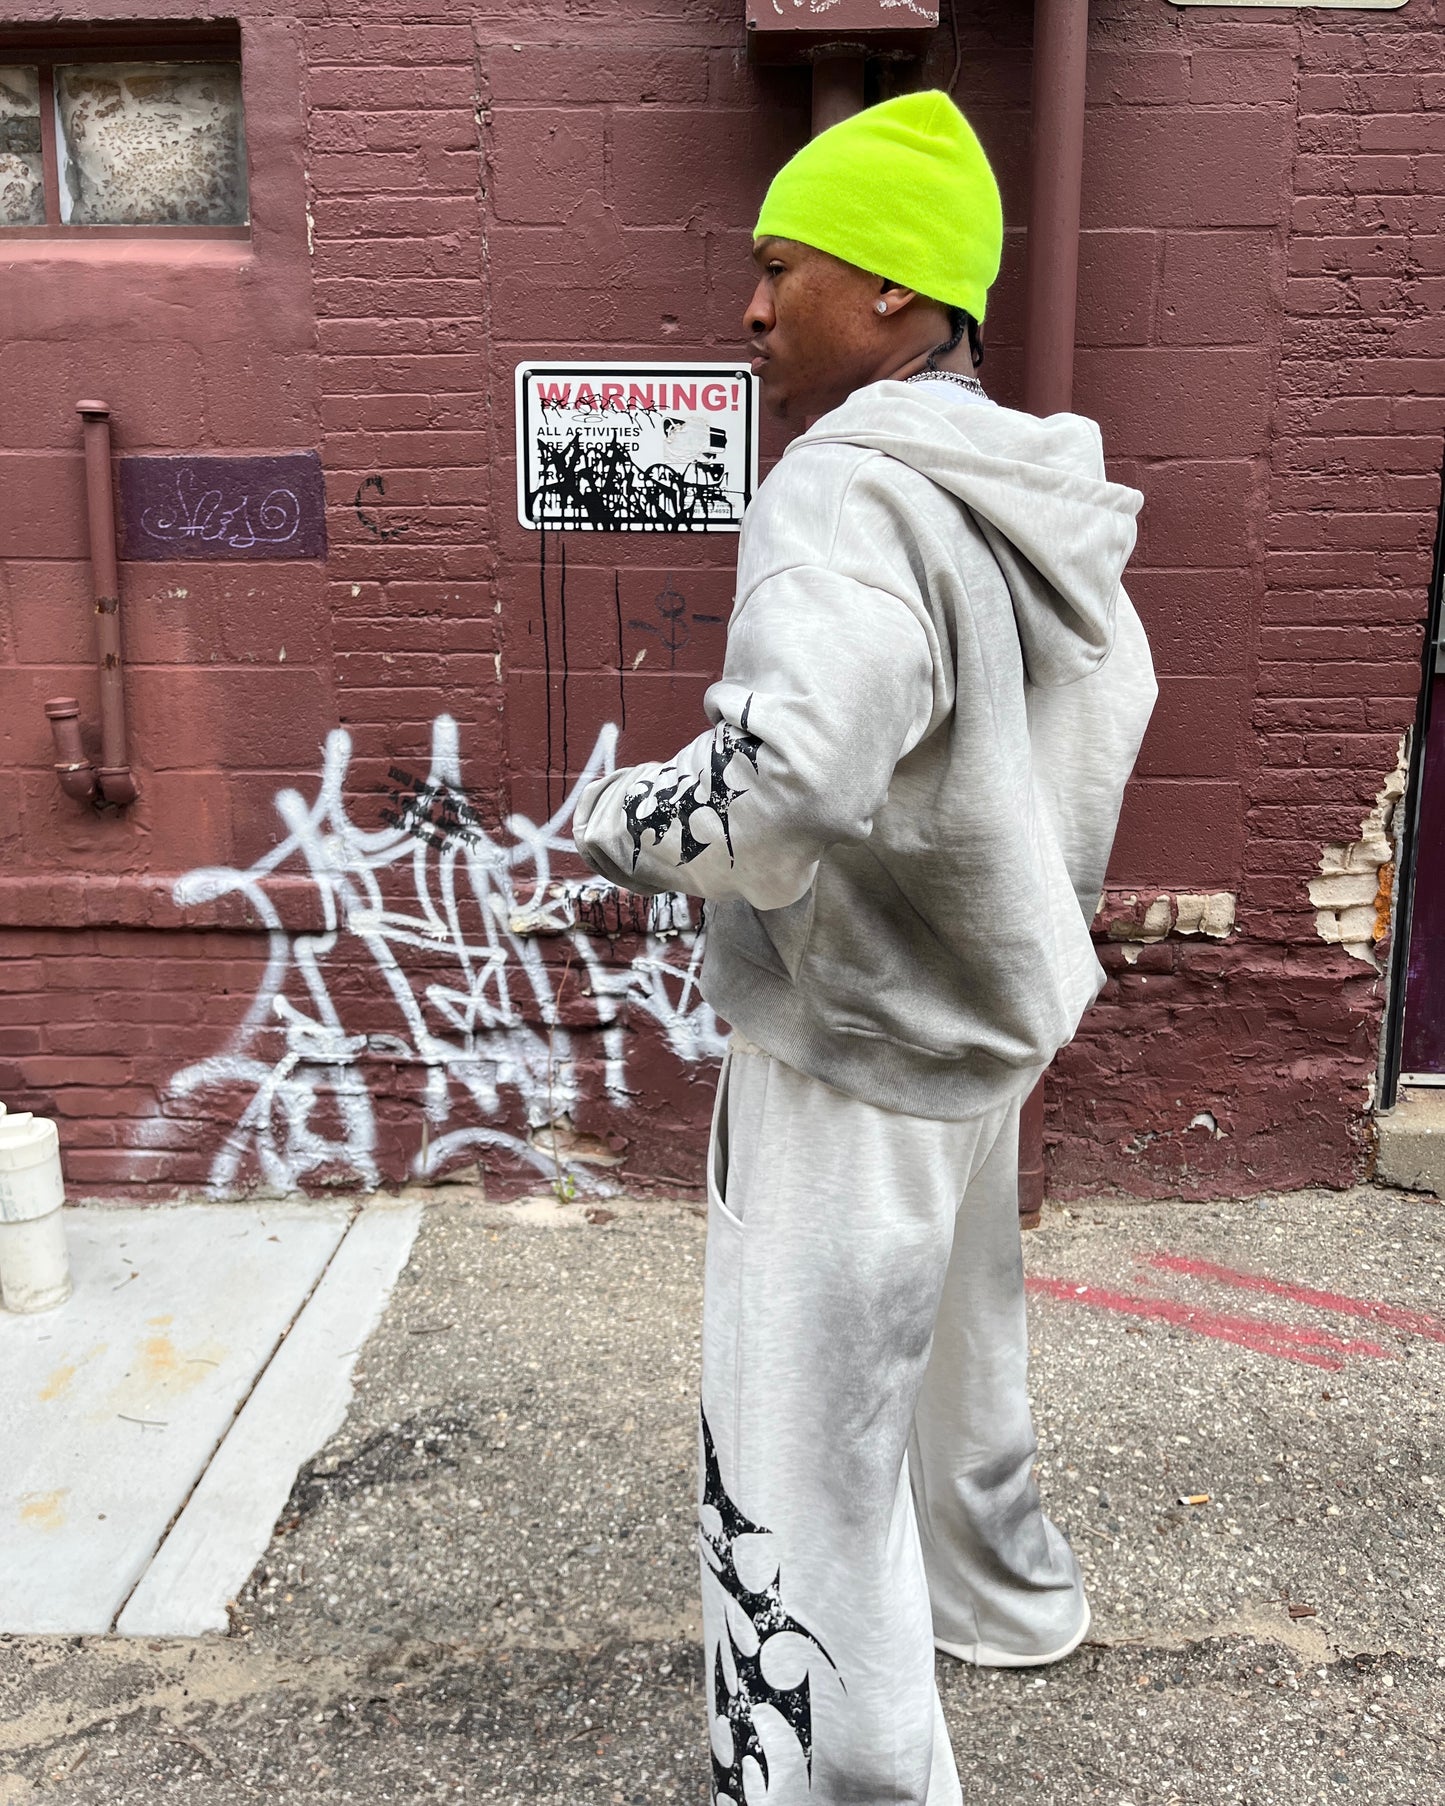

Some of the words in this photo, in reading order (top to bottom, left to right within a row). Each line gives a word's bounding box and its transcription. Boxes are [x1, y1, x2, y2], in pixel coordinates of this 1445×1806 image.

[536, 383, 740, 412] WARNING!
[537, 427, 561, 437] ALL
[566, 427, 641, 438] ACTIVITIES
[537, 441, 563, 451] RE
